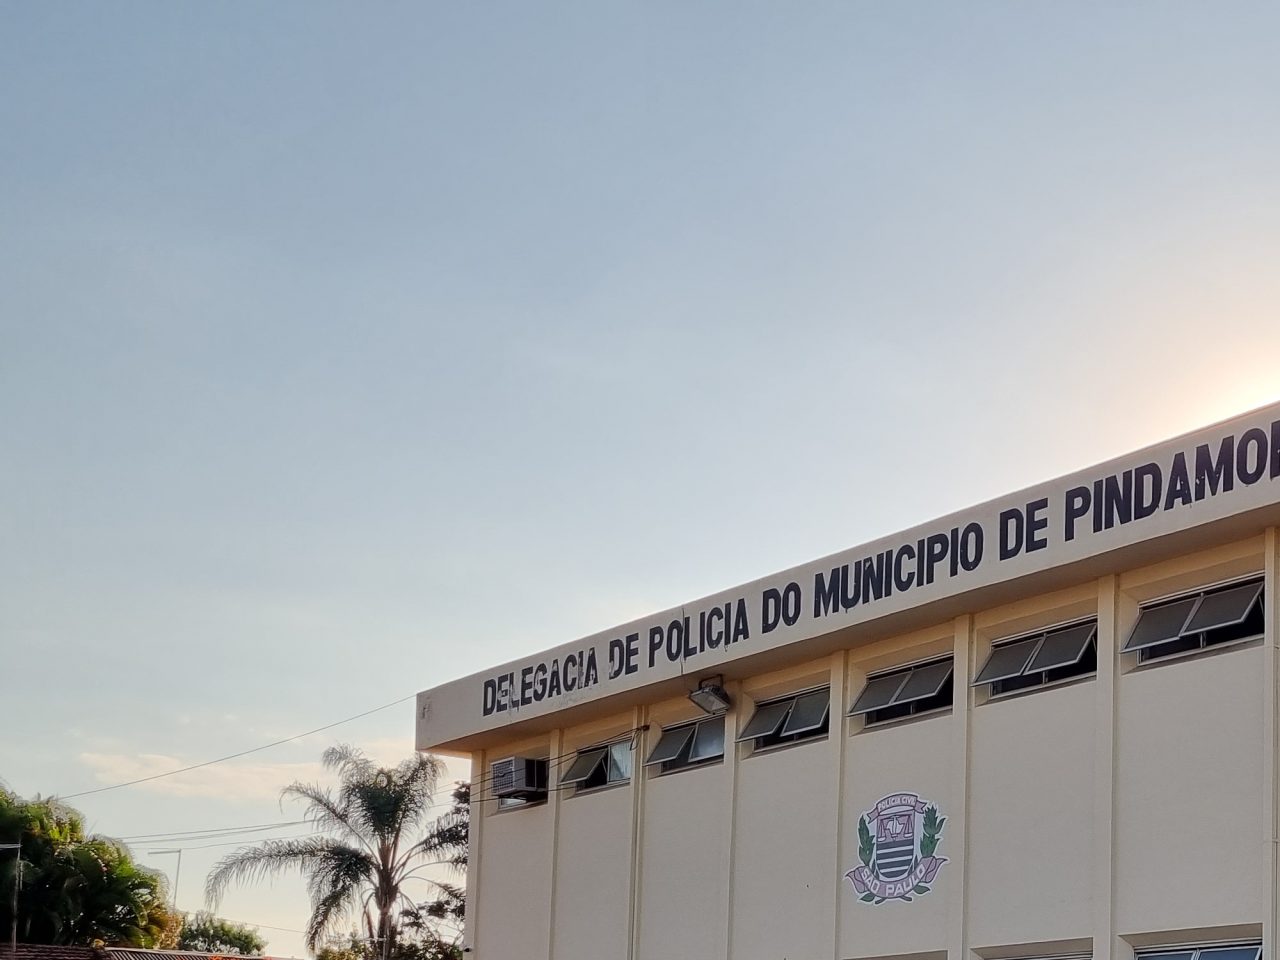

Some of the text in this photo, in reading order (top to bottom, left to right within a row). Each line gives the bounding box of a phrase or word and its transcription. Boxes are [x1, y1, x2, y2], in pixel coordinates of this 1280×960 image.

[482, 646, 599, 717] DELEGACIA
[608, 632, 640, 681] DE
[648, 599, 750, 668] POLICIA
[762, 582, 802, 635] DO
[813, 523, 984, 619] MUNICIPIO
[999, 497, 1049, 561] DE
[886, 864, 926, 896] PAULO
